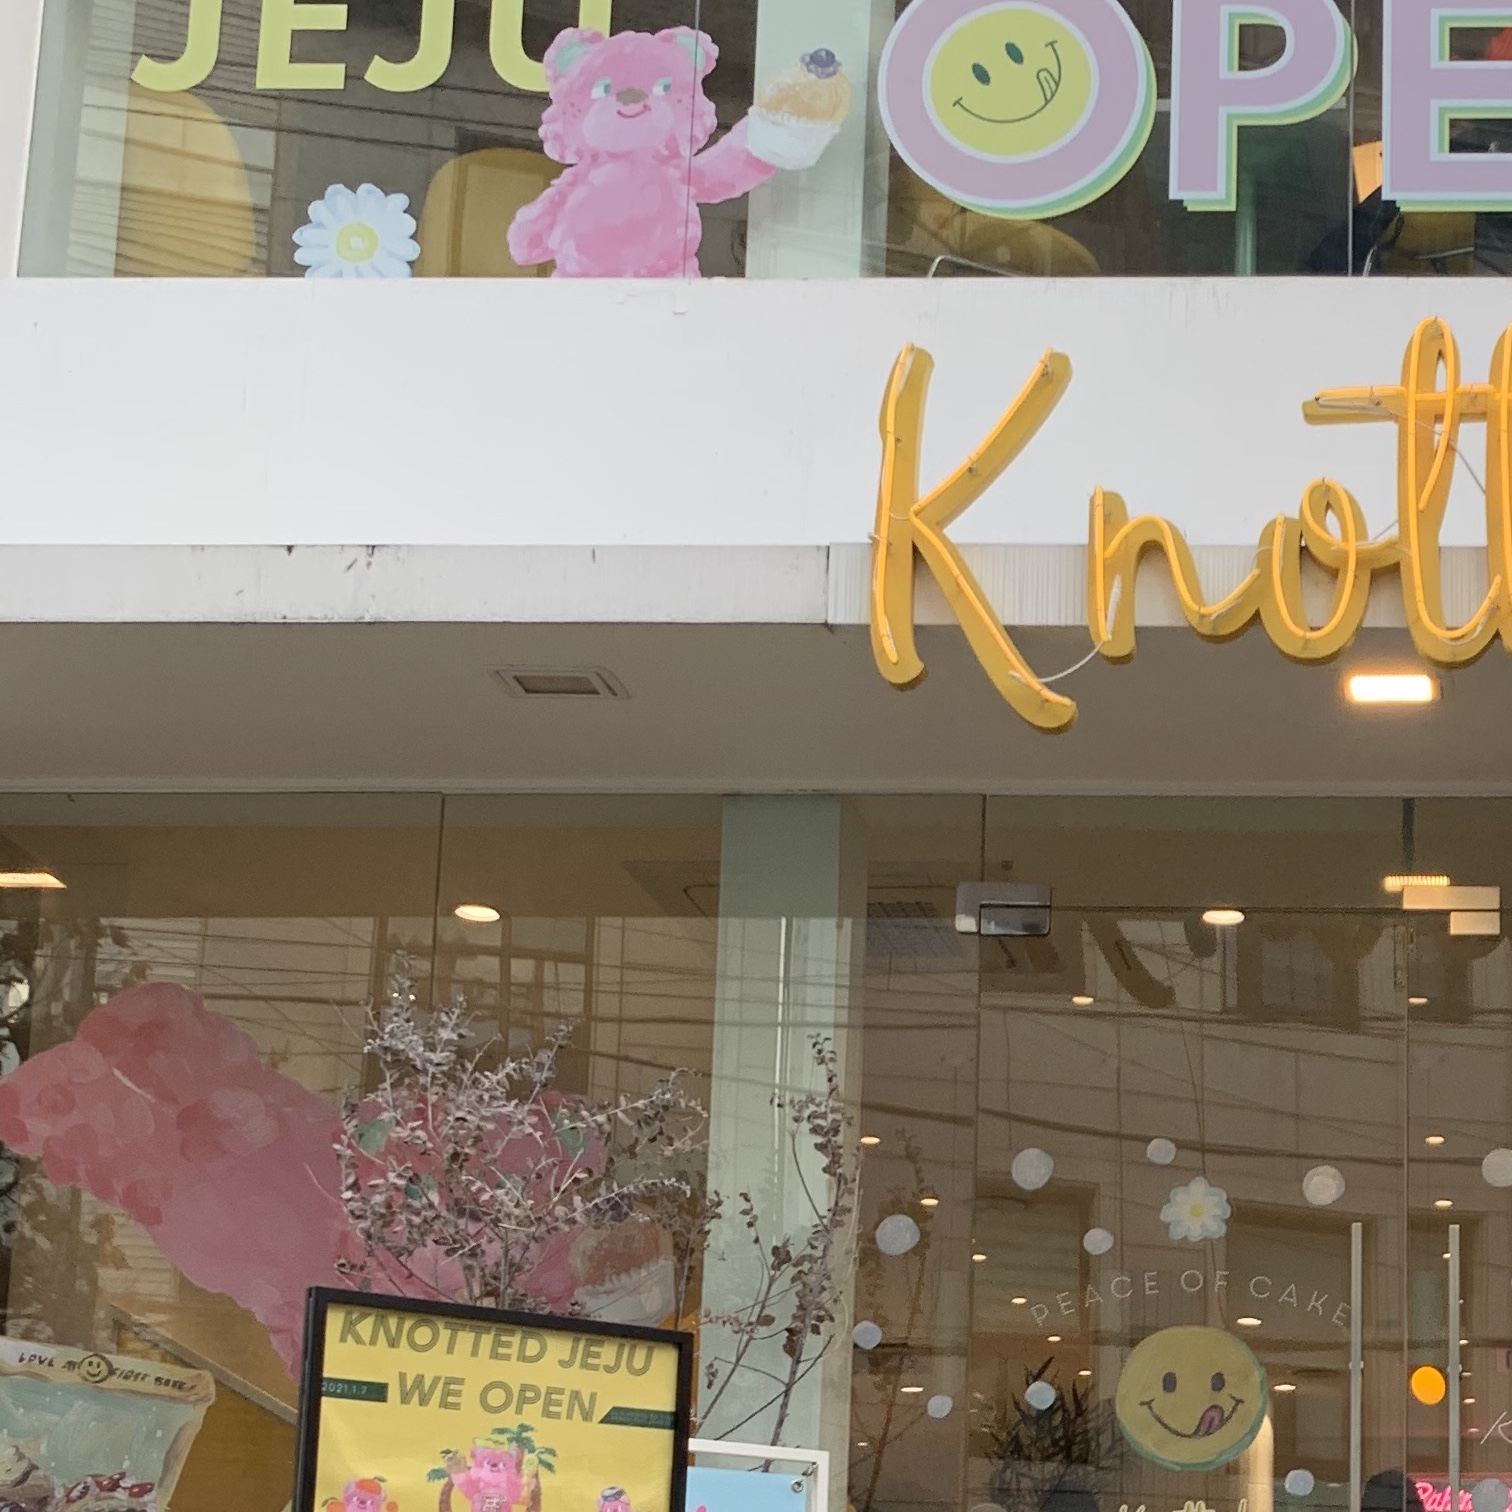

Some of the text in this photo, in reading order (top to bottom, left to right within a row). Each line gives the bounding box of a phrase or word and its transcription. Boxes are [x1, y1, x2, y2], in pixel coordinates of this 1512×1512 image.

[1030, 1268, 1352, 1328] PEACE OF CAKE
[338, 1309, 655, 1378] KNOTTED JEJU
[398, 1371, 465, 1412] WE
[479, 1385, 598, 1424] OPEN
